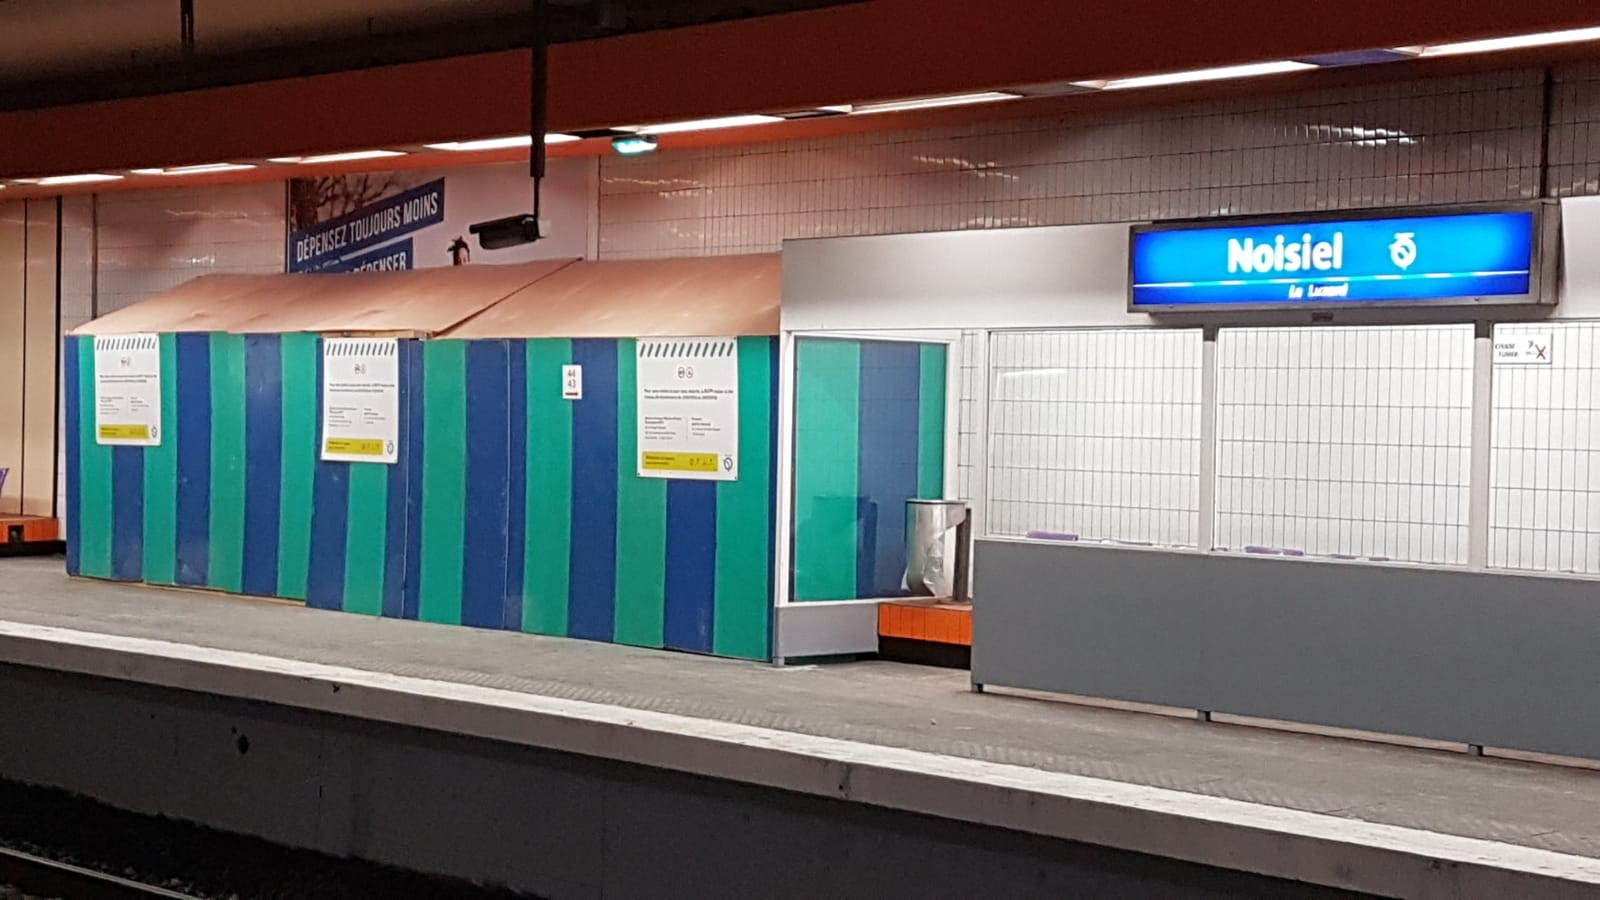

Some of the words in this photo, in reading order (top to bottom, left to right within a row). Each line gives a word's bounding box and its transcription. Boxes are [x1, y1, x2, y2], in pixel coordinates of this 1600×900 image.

[296, 224, 347, 262] DÉPENSEZ
[350, 207, 401, 243] TOUJOURS
[403, 191, 438, 223] MOINS
[1227, 231, 1343, 273] Noisiel
